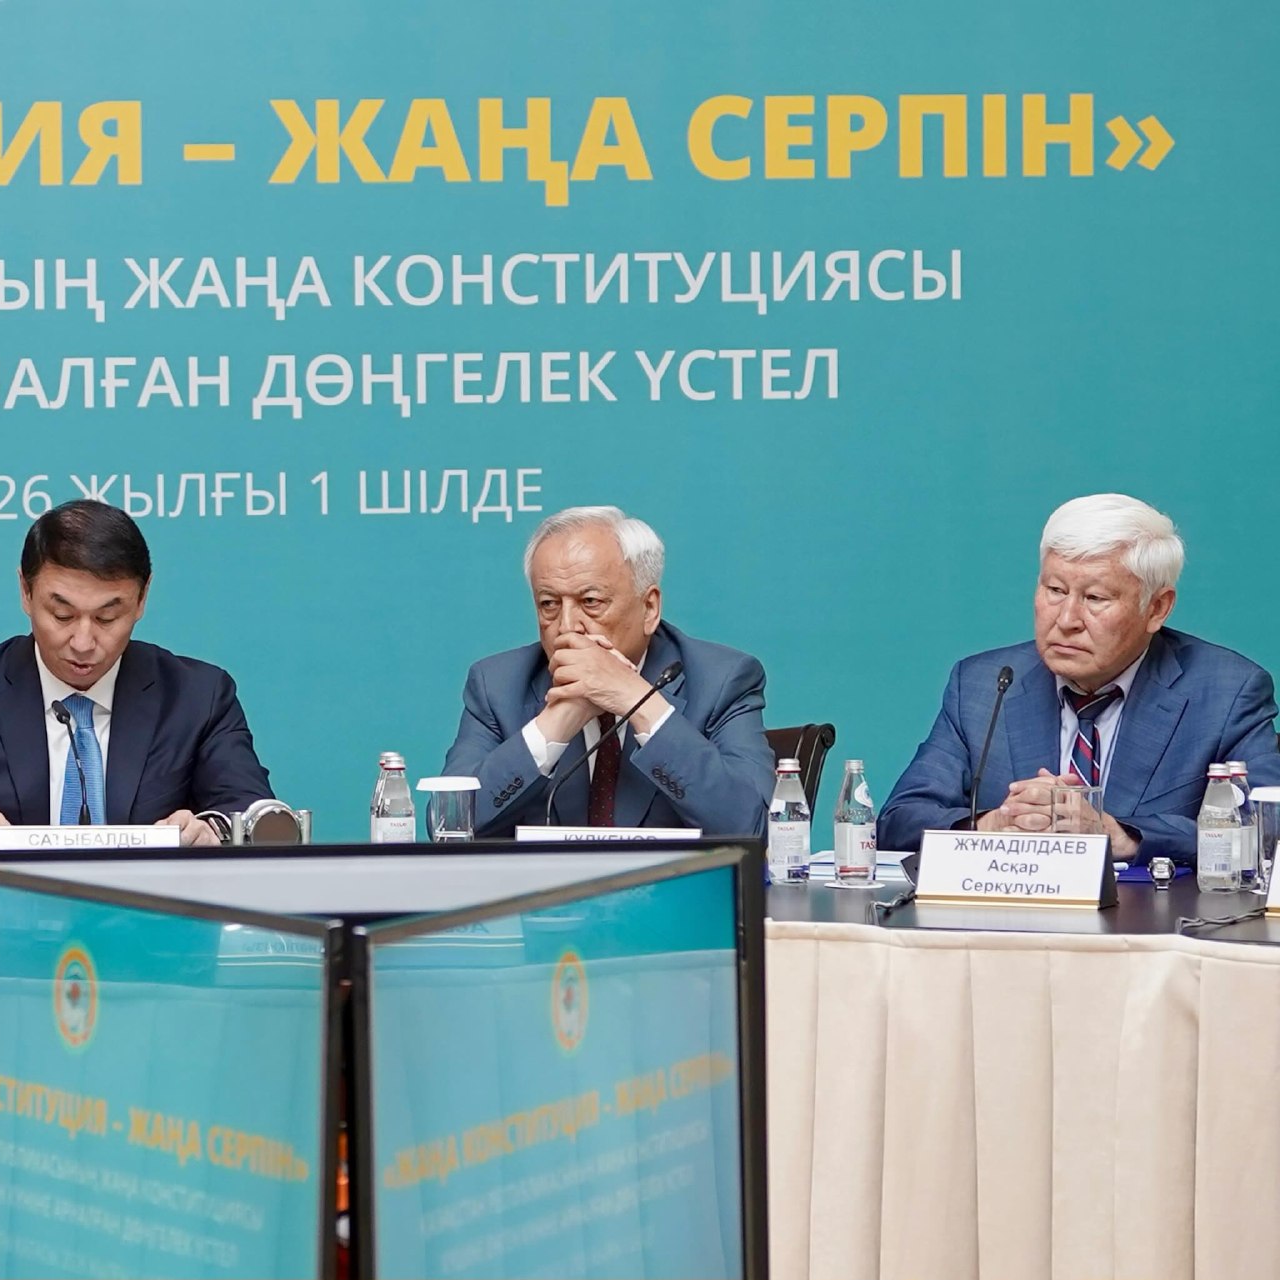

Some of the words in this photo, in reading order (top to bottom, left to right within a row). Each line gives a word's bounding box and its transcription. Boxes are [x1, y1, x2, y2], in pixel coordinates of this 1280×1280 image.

[269, 97, 653, 207] ЖАҢА
[687, 93, 1176, 181] СЕРПІН»
[123, 256, 333, 321] ЖАҢА
[353, 249, 963, 315] КОНСТИТУЦИЯСЫ
[251, 351, 618, 420] ДӨҢГЕЛЕК
[635, 348, 840, 401] ҮСТЕЛ
[70, 472, 288, 518] ЖЫЛҒЫ
[310, 471, 329, 515] 1
[358, 469, 543, 523] ШІЛДЕ
[954, 837, 1088, 856] ЖҰМАДІЛДАЕВ
[987, 859, 1040, 876] Асқар
[961, 878, 1061, 895] Серкұлұлы
